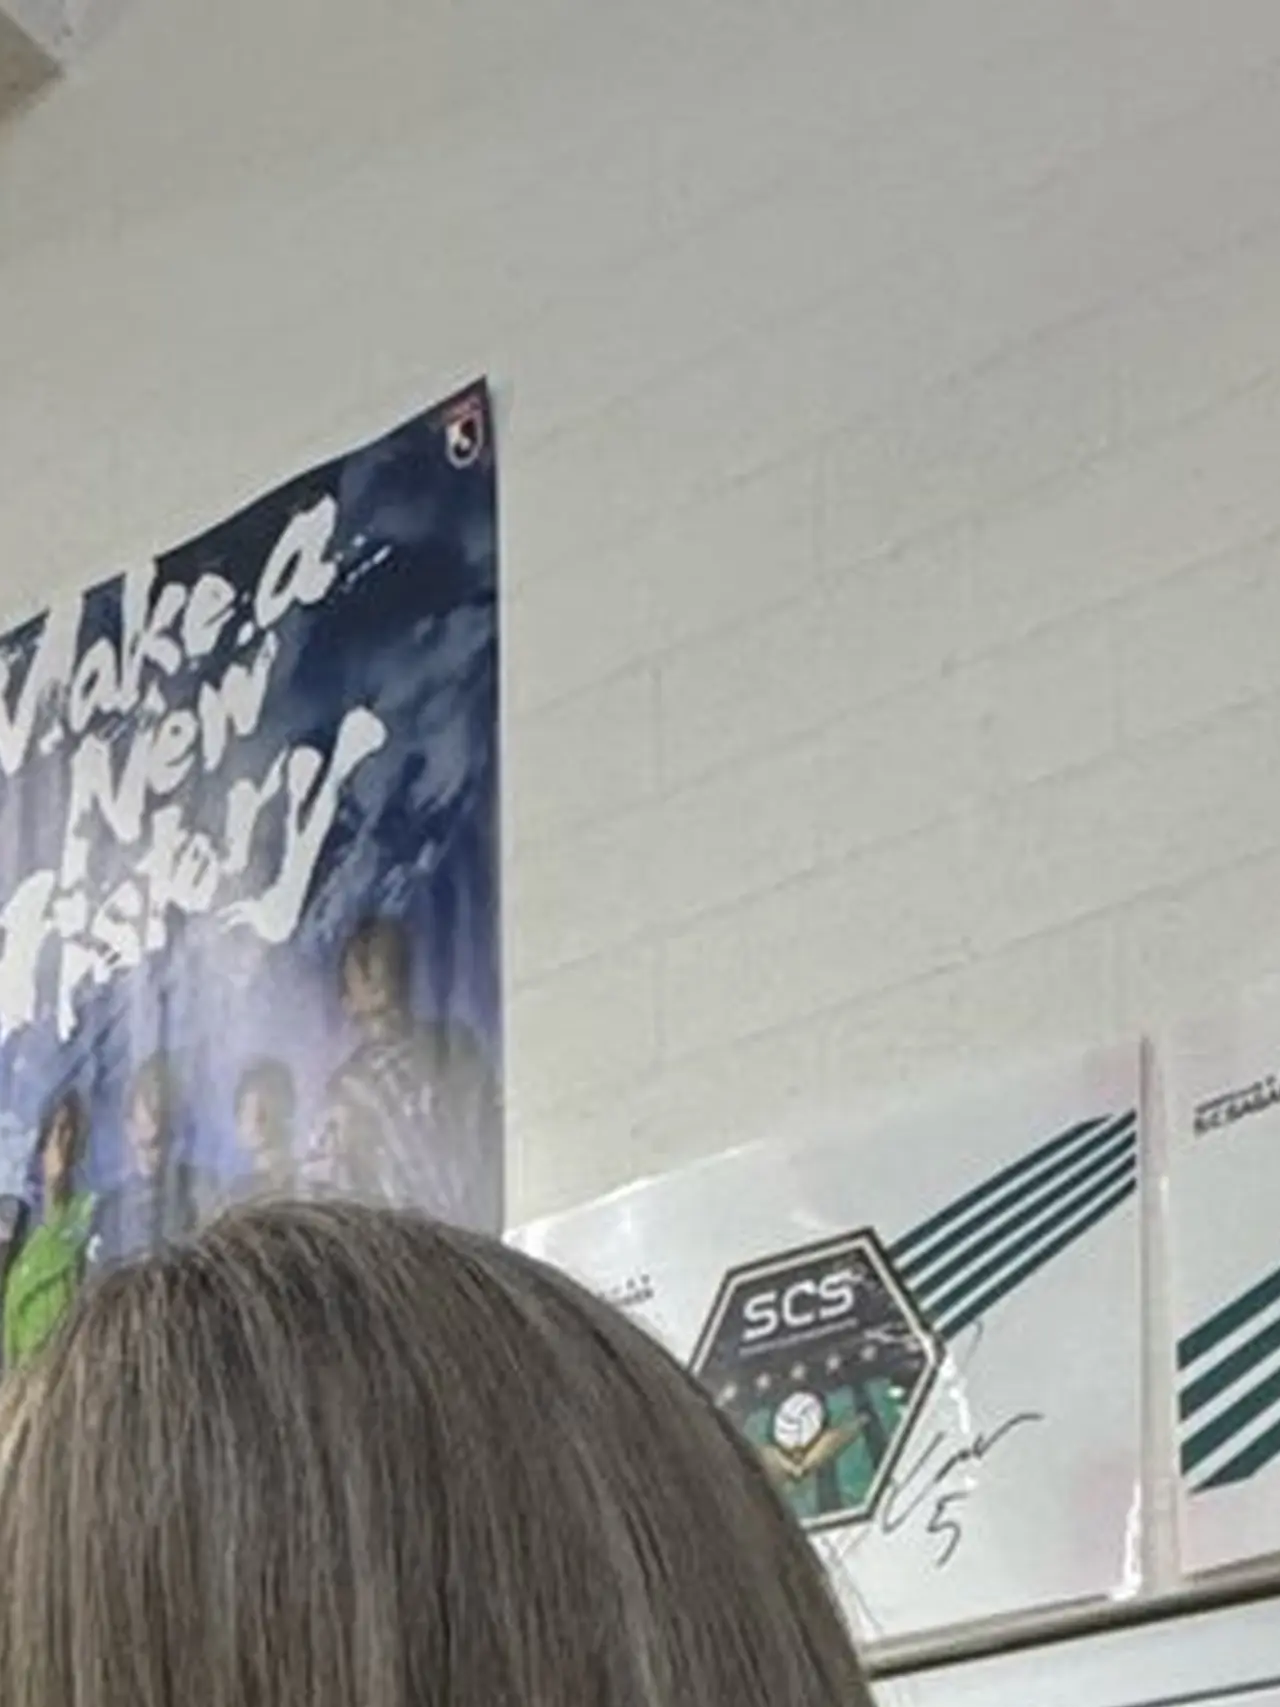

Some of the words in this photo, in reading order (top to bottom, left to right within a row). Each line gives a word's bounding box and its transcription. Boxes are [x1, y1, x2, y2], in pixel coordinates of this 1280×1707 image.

[60, 631, 279, 890] New
[742, 1268, 855, 1343] SCS
[926, 1490, 970, 1568] 5
